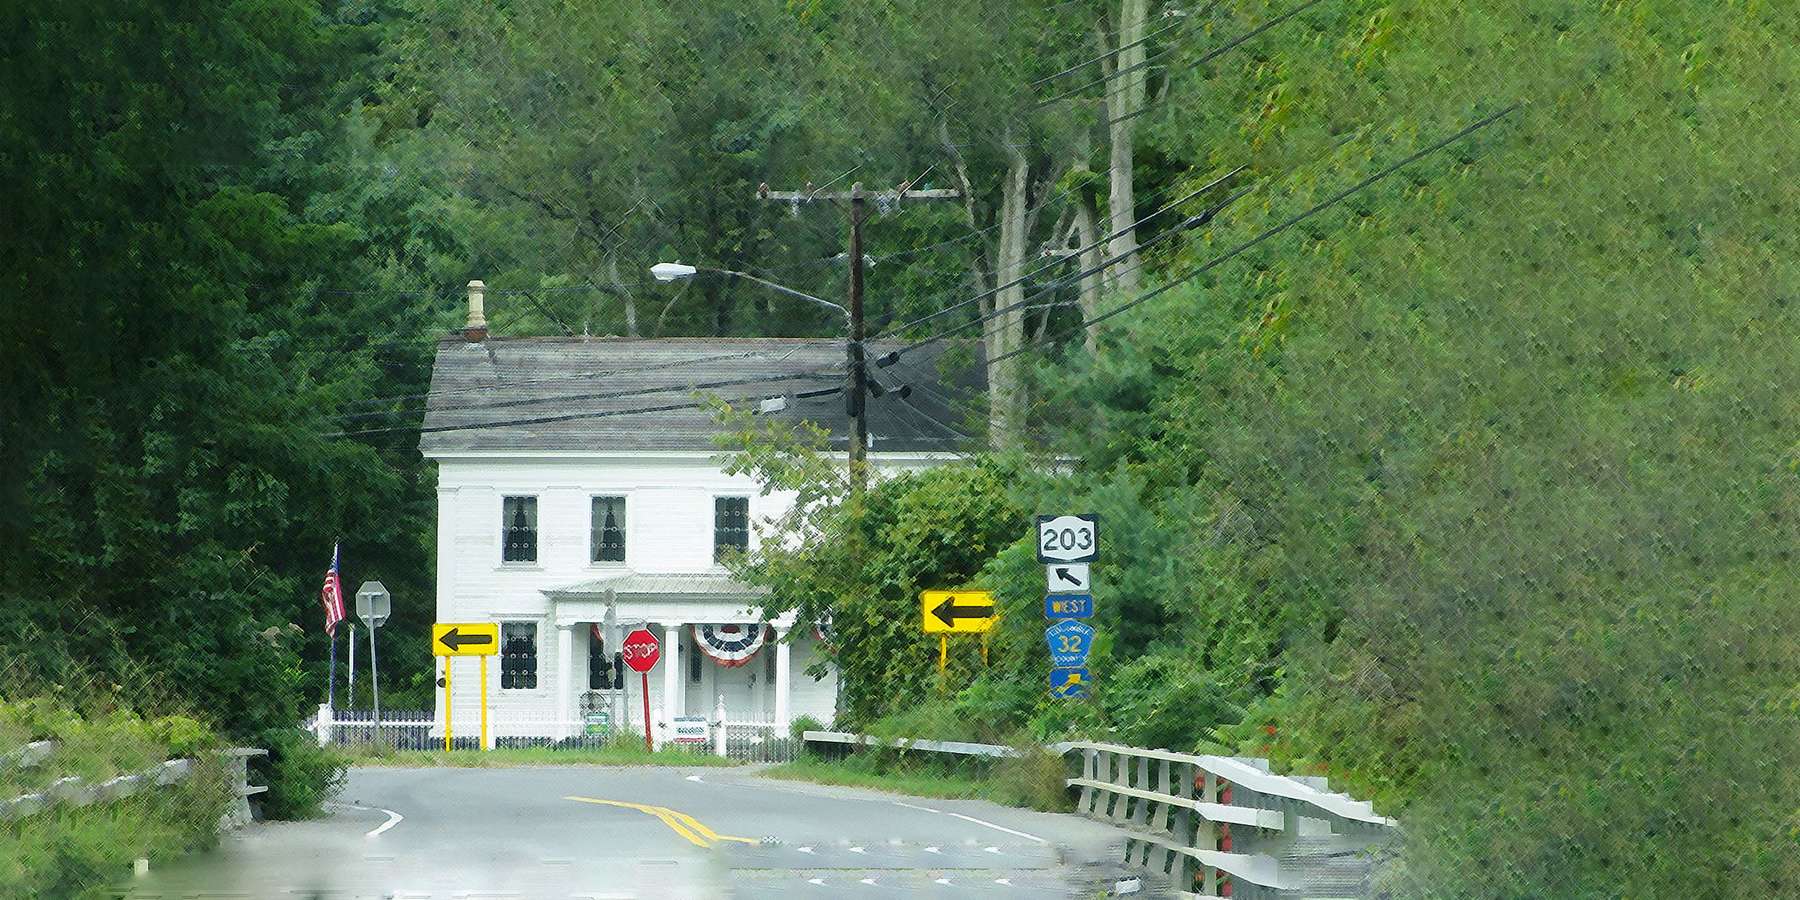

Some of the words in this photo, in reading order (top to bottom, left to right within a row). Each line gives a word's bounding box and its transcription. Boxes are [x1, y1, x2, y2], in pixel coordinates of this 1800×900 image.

[1043, 527, 1092, 550] 203
[624, 642, 658, 660] STOP
[1059, 635, 1082, 653] 32
